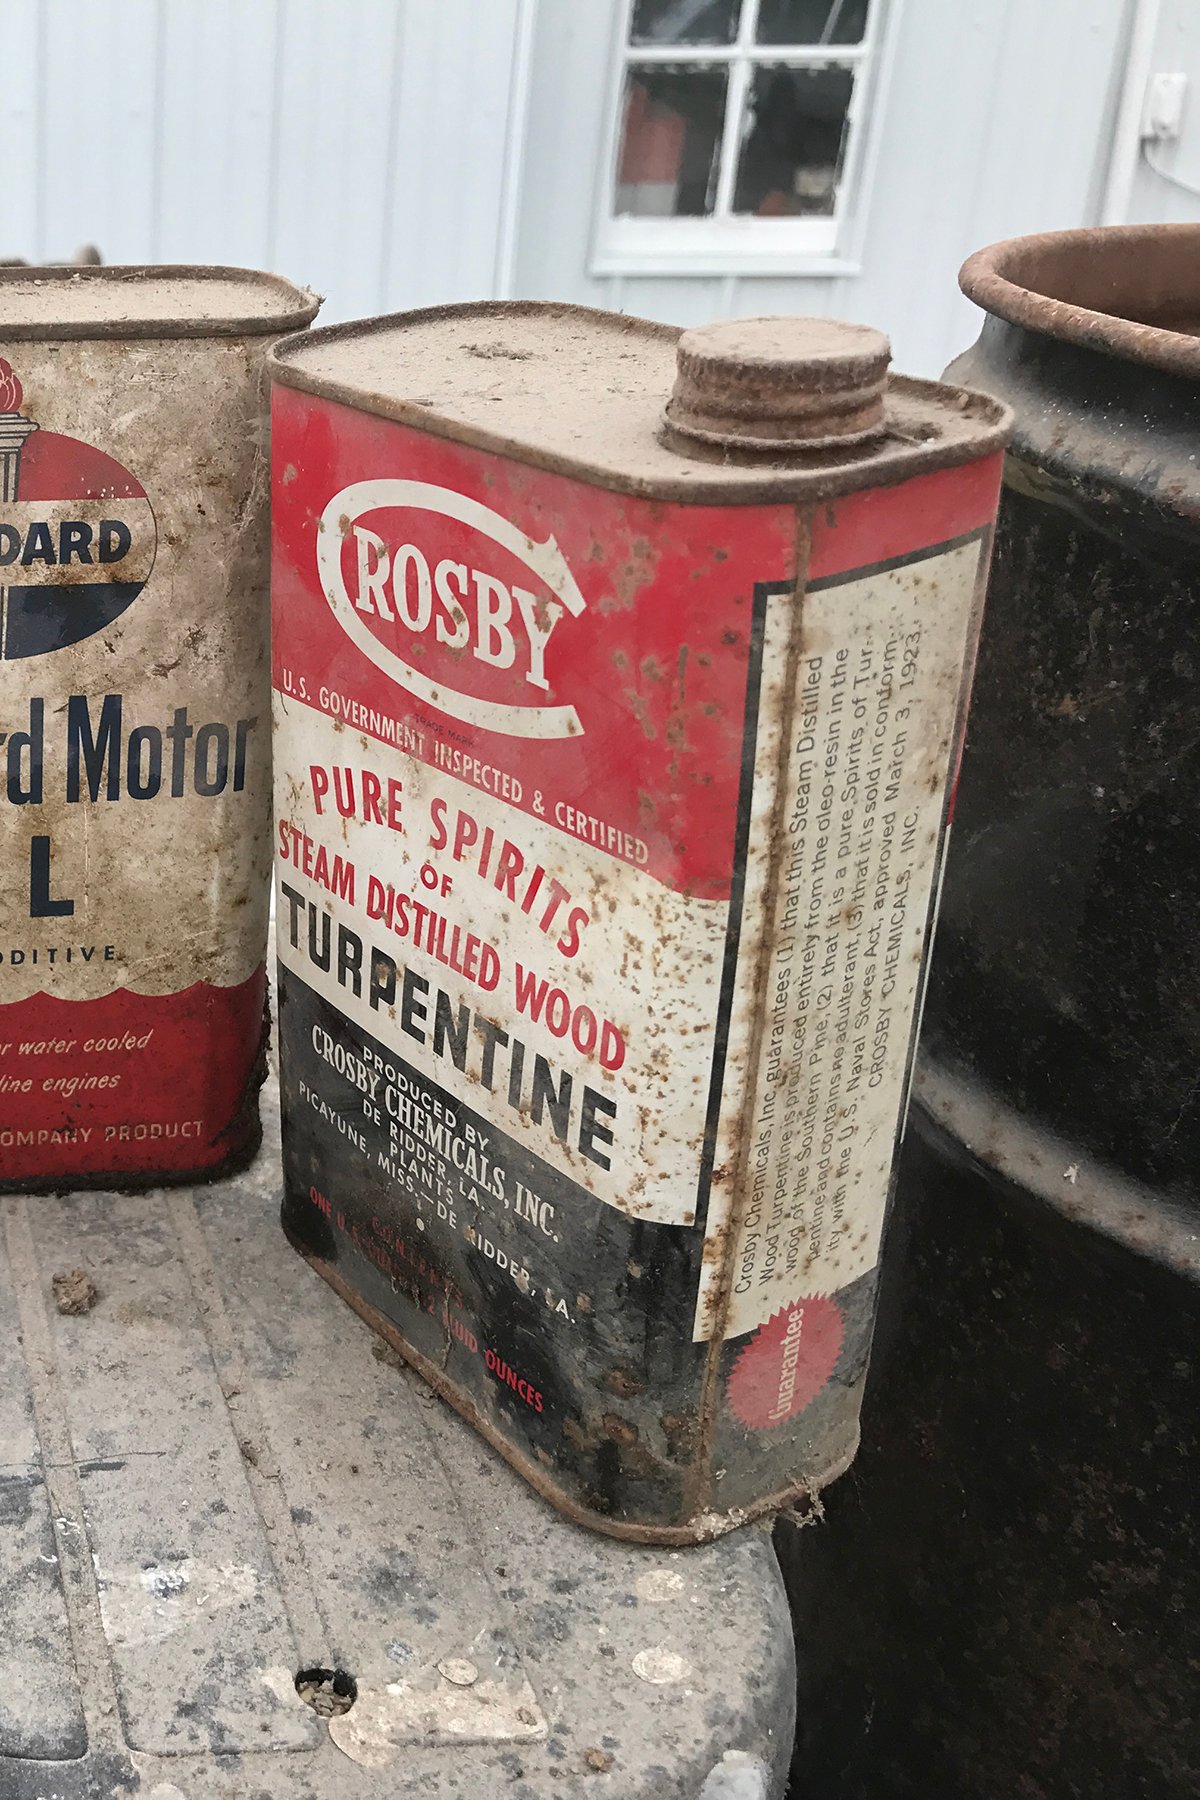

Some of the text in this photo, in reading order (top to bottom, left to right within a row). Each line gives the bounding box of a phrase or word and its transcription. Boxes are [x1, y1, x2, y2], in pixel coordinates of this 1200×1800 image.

[796, 656, 823, 753] Distilled
[850, 695, 867, 718] of
[895, 699, 912, 720] 3,
[66, 694, 258, 803] Motor
[282, 668, 649, 865] U.S. GOVERNMENT INSPECTED & CERTIFIED
[841, 727, 865, 801] Spirits
[868, 742, 882, 762] in
[885, 730, 906, 800] March
[792, 759, 813, 832] Steam
[862, 767, 879, 813] sold
[838, 809, 856, 858] pure
[857, 835, 871, 852] it
[859, 817, 873, 834] is
[309, 765, 590, 958] PURE SPIRITS
[420, 863, 453, 898] OF
[787, 838, 804, 880] this
[837, 866, 847, 878] a
[852, 856, 868, 900] that
[872, 811, 896, 910] approved
[781, 885, 800, 929] that
[826, 911, 841, 926] it
[829, 887, 844, 904] is
[278, 819, 626, 1071] STEAM DISTILLED WOOD
[777, 936, 794, 962] (1)
[821, 932, 838, 976] that
[864, 917, 882, 956] Act,
[869, 805, 918, 1087] CROSBY CHEMICALS, INC.
[760, 648, 848, 1285] Wood Turpentine is produced entirely from the oleo-resin in the
[834, 933, 859, 1040] adulterant,
[817, 985, 833, 1010] (2)
[855, 964, 875, 1028] Stores
[19, 1037, 76, 1056] water
[83, 1030, 154, 1051] cooled
[281, 880, 617, 1173] TURPENTINE
[765, 968, 793, 1080] guarantees
[810, 1012, 829, 1065] Pine,
[42, 1071, 121, 1098] engines
[847, 1036, 865, 1091] Naval
[299, 1080, 371, 1160] PICAYUNE,
[363, 1045, 490, 1152] PRODUCED BY
[363, 1098, 382, 1127] DE
[797, 1072, 819, 1161] Southern
[820, 1070, 841, 1154] contains
[104, 1120, 204, 1142] PRODUCT
[311, 1024, 559, 1243] CROSBY CHEMICALS, INC.
[389, 1140, 454, 1206] PLANTS
[792, 1165, 808, 1196] the
[814, 1159, 829, 1191] and
[836, 1146, 850, 1177] the
[310, 1185, 331, 1218] ONE
[789, 1202, 803, 1219] of
[830, 1184, 846, 1224] with
[783, 1226, 800, 1273] wood
[807, 1196, 826, 1261] pentine
[827, 1230, 841, 1251] ity
[736, 1232, 759, 1293] Crosby
[484, 1348, 543, 1412] OUNCES
[767, 1307, 805, 1421] Guarantee
